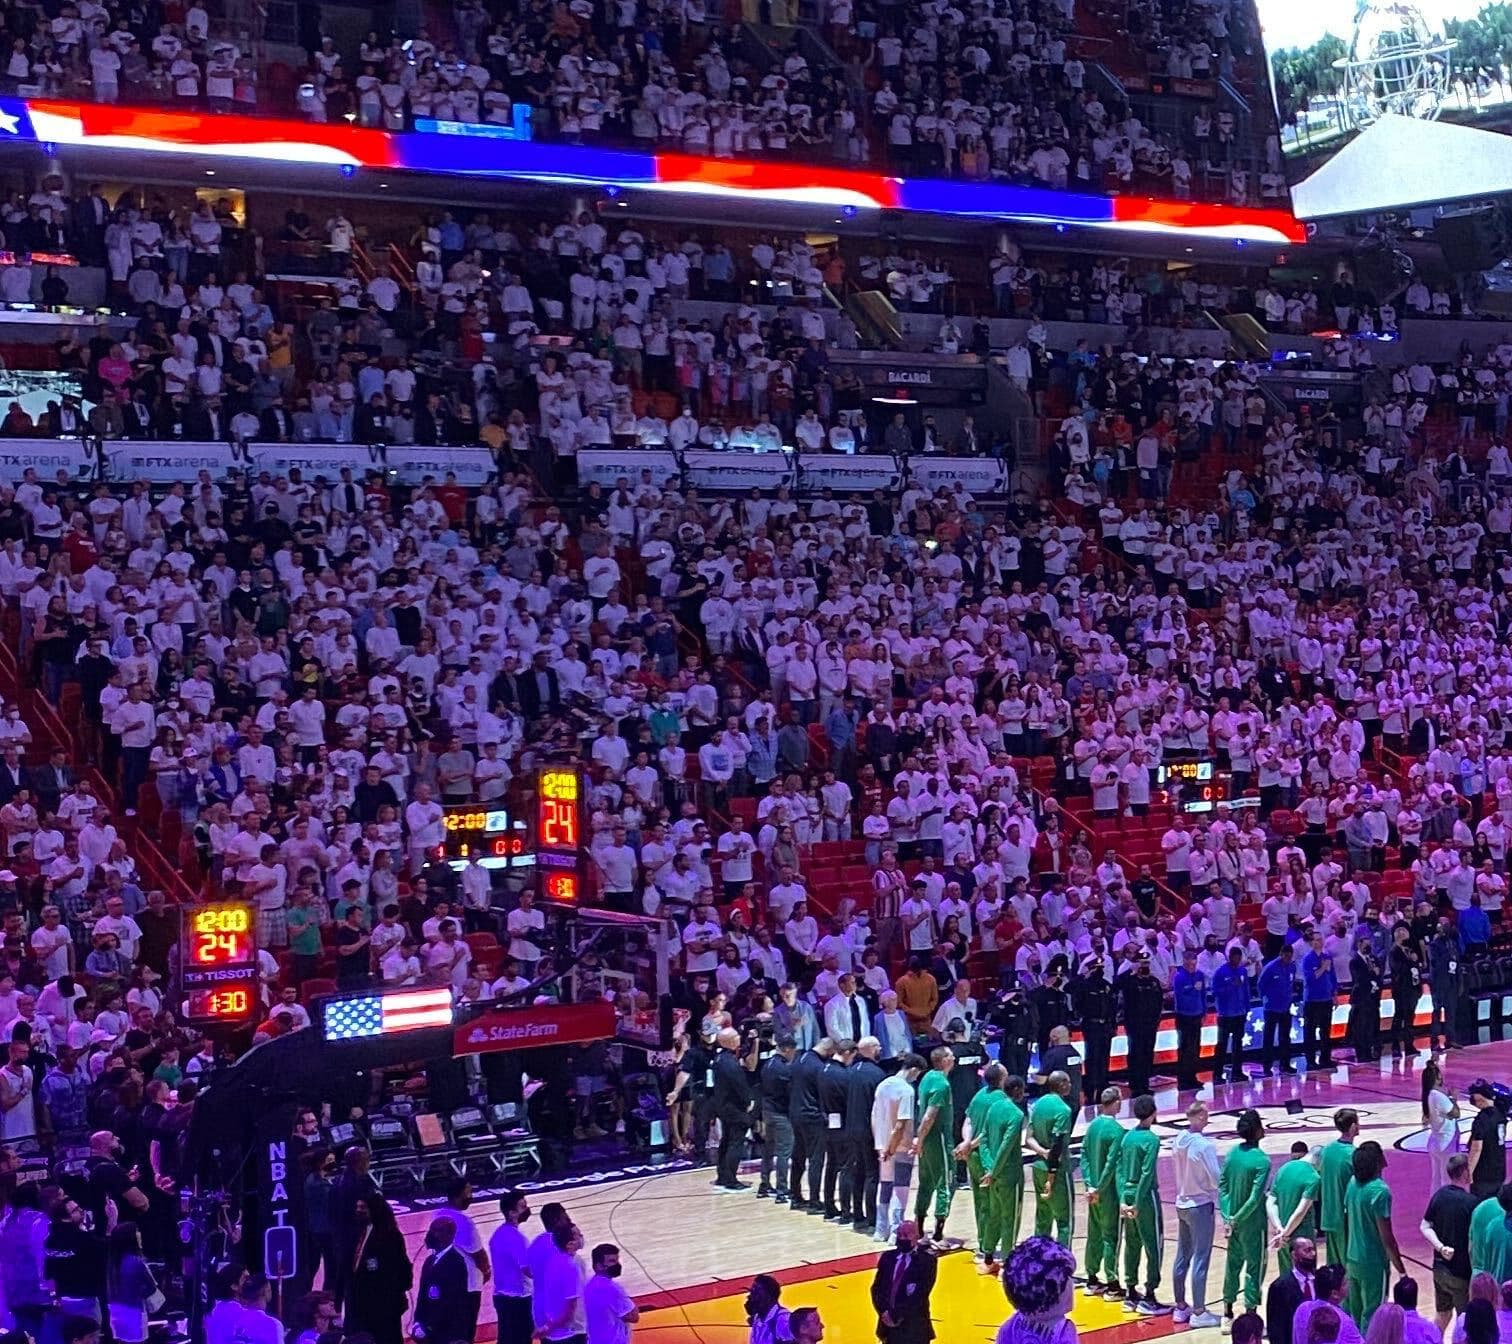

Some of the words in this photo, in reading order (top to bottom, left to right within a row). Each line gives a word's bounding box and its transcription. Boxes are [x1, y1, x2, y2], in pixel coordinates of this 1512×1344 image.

[0, 455, 20, 466] TX
[23, 456, 71, 467] arena
[146, 458, 171, 468] FTX
[174, 458, 219, 468] arena
[289, 460, 312, 469] FTX
[416, 462, 440, 471] FTX
[605, 465, 627, 474] FTX
[937, 471, 957, 479] FTX
[957, 471, 990, 480] arena
[544, 801, 573, 843] 24
[495, 840, 506, 855] 0
[512, 839, 522, 854] 0
[196, 909, 247, 933] 12:00
[199, 933, 237, 961] 24
[205, 968, 255, 981] TISSOT
[515, 1170, 622, 1191] Google
